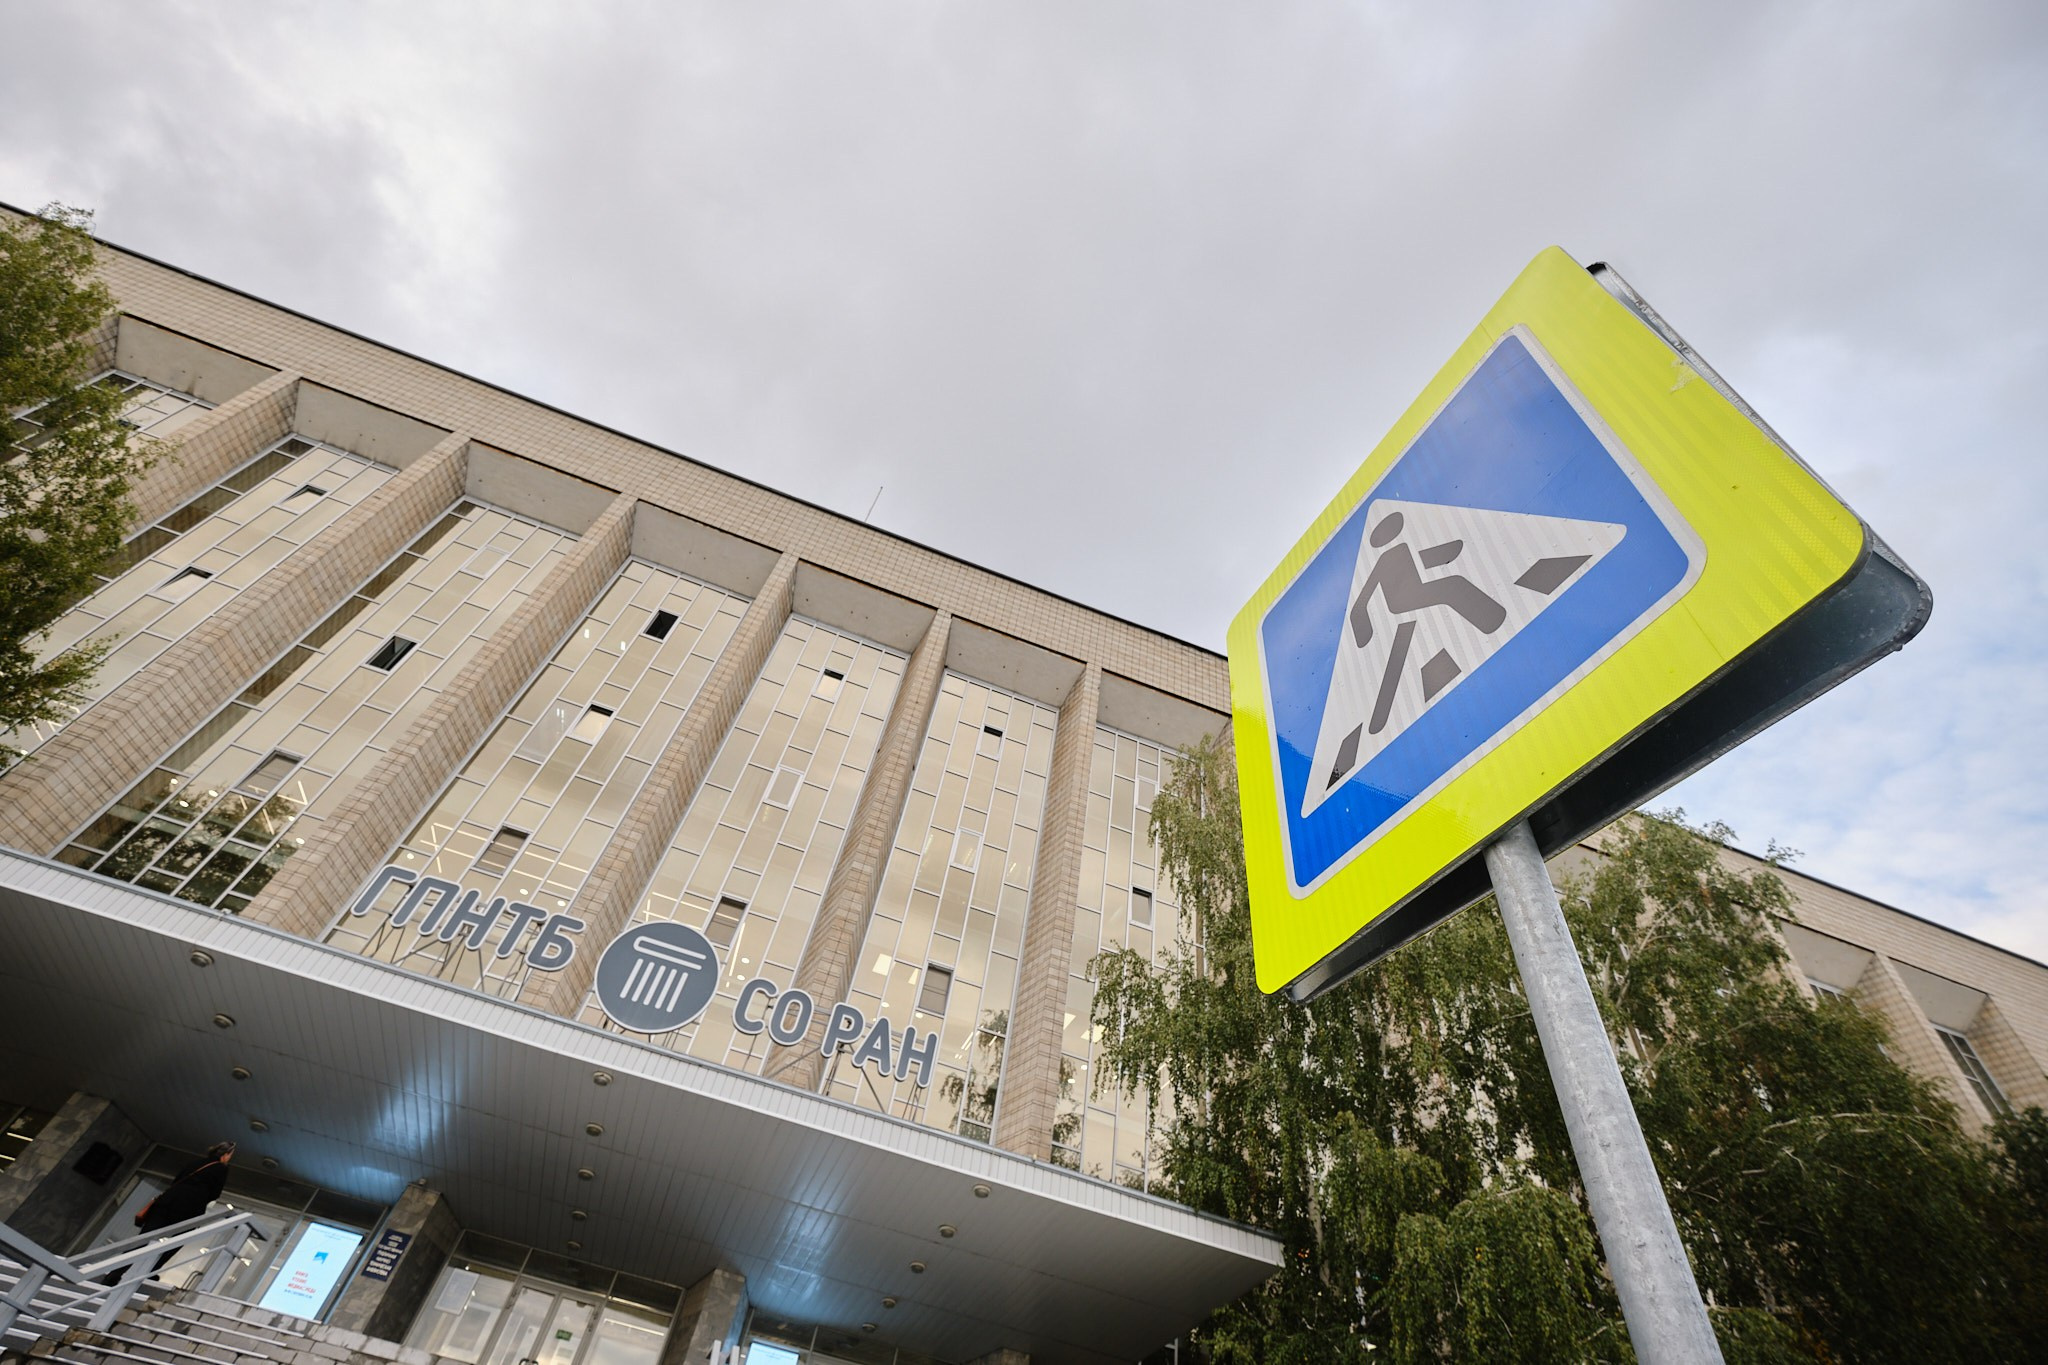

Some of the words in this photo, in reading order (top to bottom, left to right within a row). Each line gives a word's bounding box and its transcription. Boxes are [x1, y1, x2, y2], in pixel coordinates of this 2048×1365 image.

[352, 865, 585, 972] ГПНТБ
[733, 978, 812, 1046] СО
[821, 1002, 938, 1088] РАН
